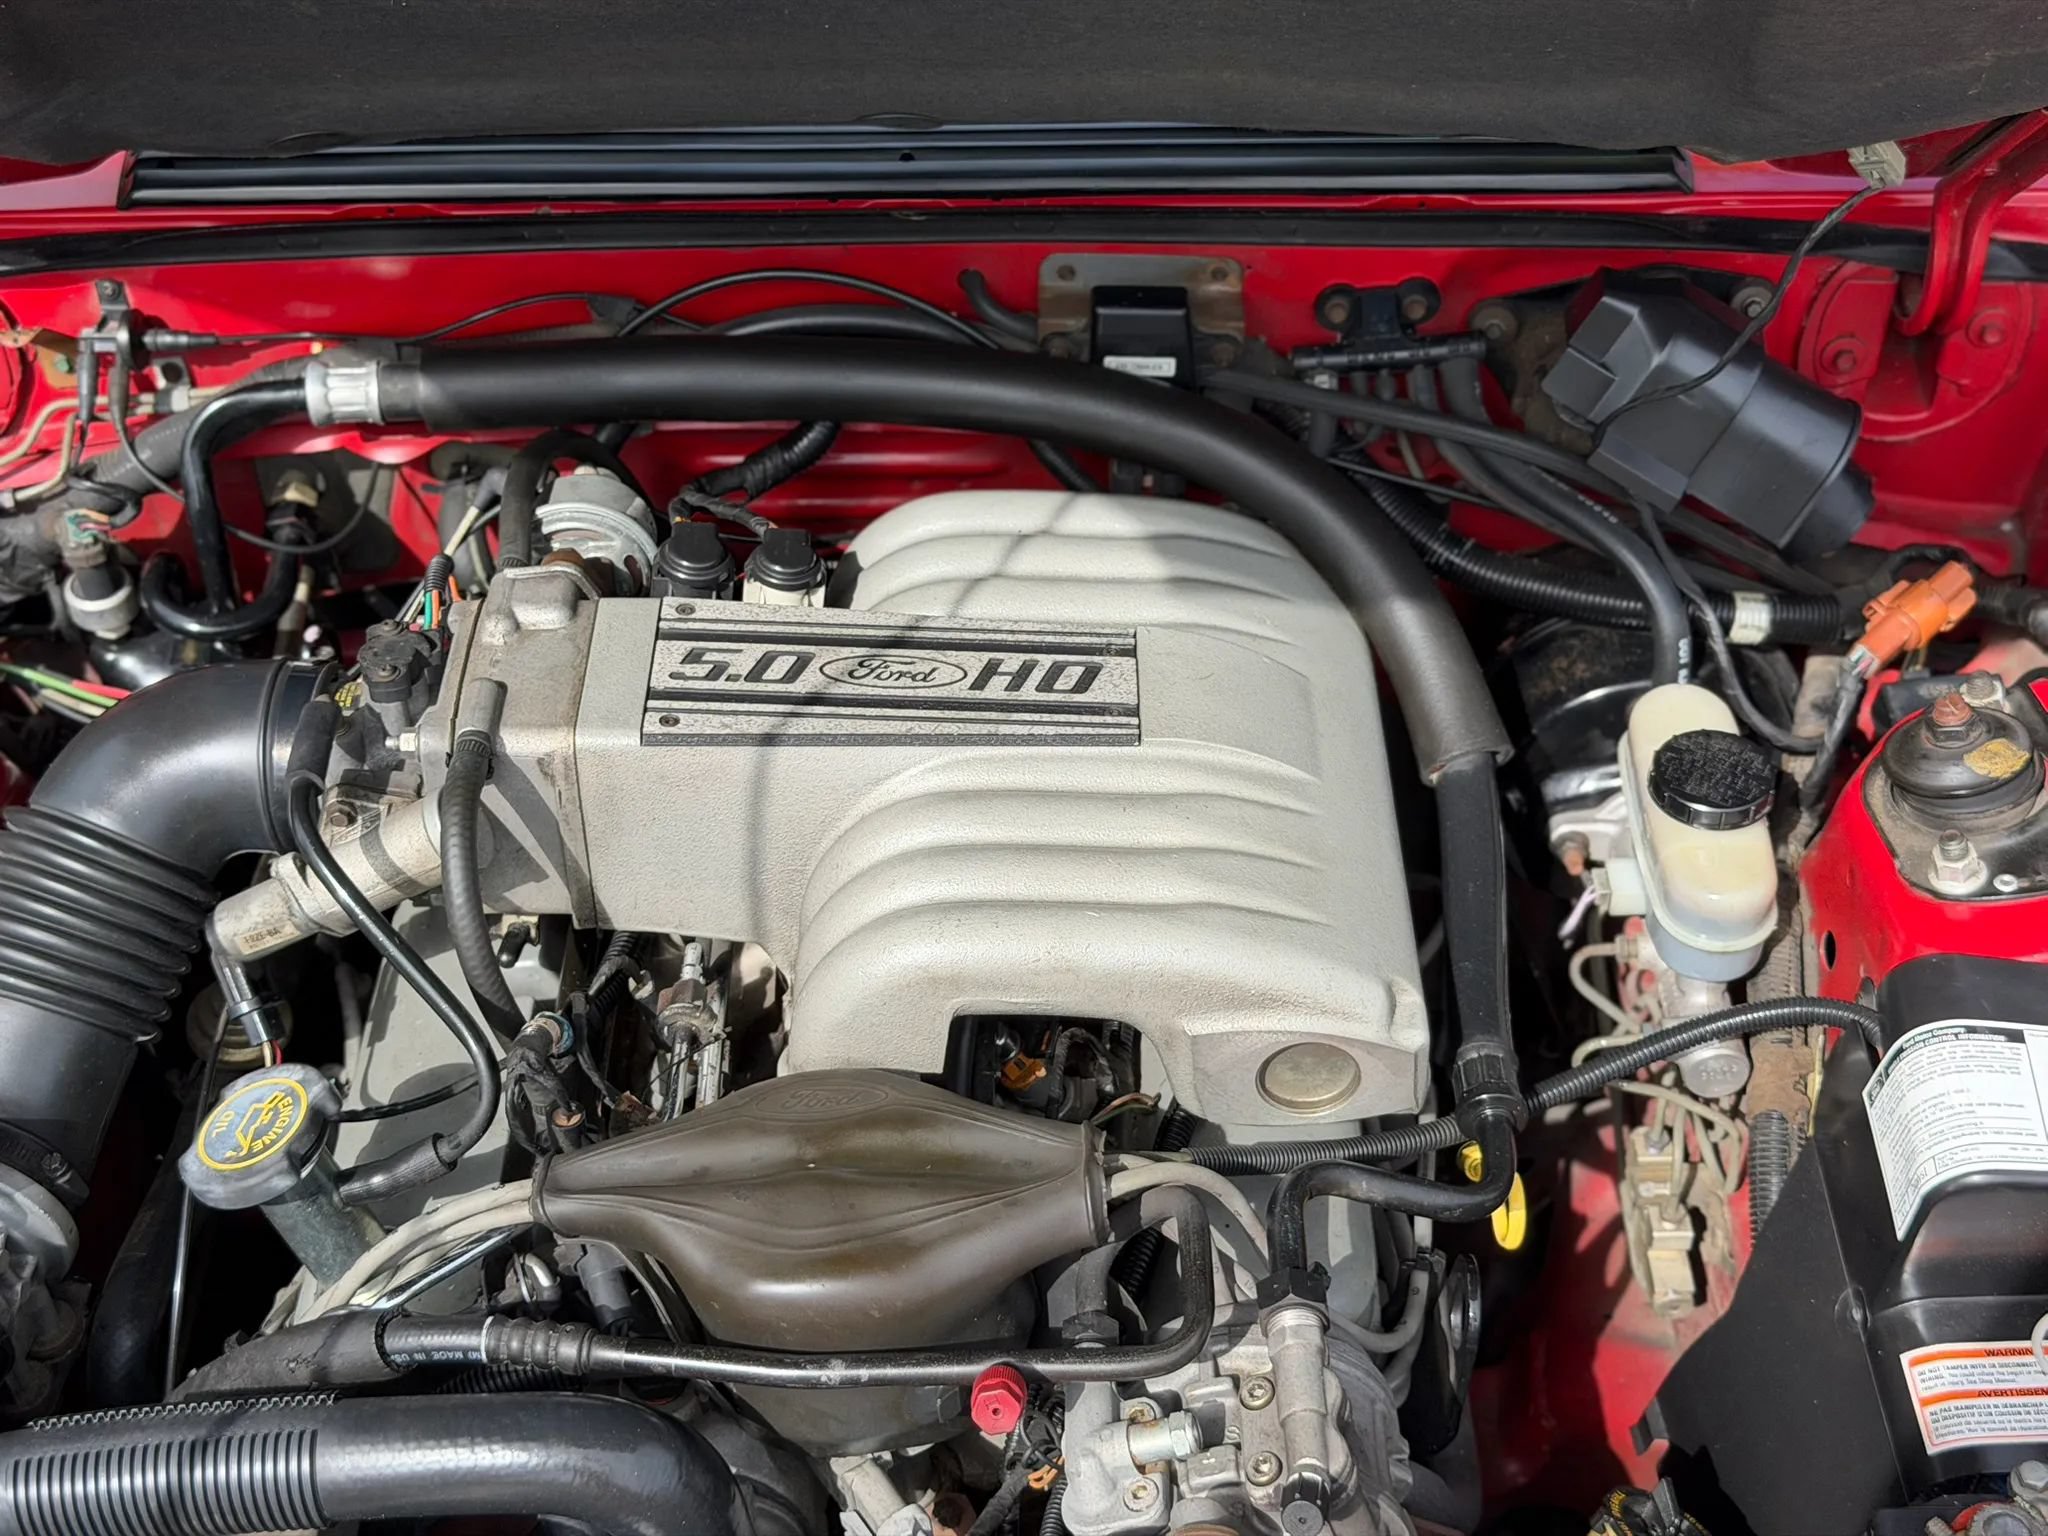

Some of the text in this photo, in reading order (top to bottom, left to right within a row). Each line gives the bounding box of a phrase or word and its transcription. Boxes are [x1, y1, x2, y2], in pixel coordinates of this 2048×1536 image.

[668, 648, 1105, 695] 5.0 Ford HO
[1924, 1034, 1957, 1046] CONTROL
[1957, 1032, 2006, 1042] INFORMATION
[782, 1088, 863, 1109] Ford
[212, 1110, 236, 1138] OIL
[251, 1096, 294, 1152] ENGINE
[432, 1351, 464, 1360] MADE
[1983, 1348, 2035, 1358] WARNIN
